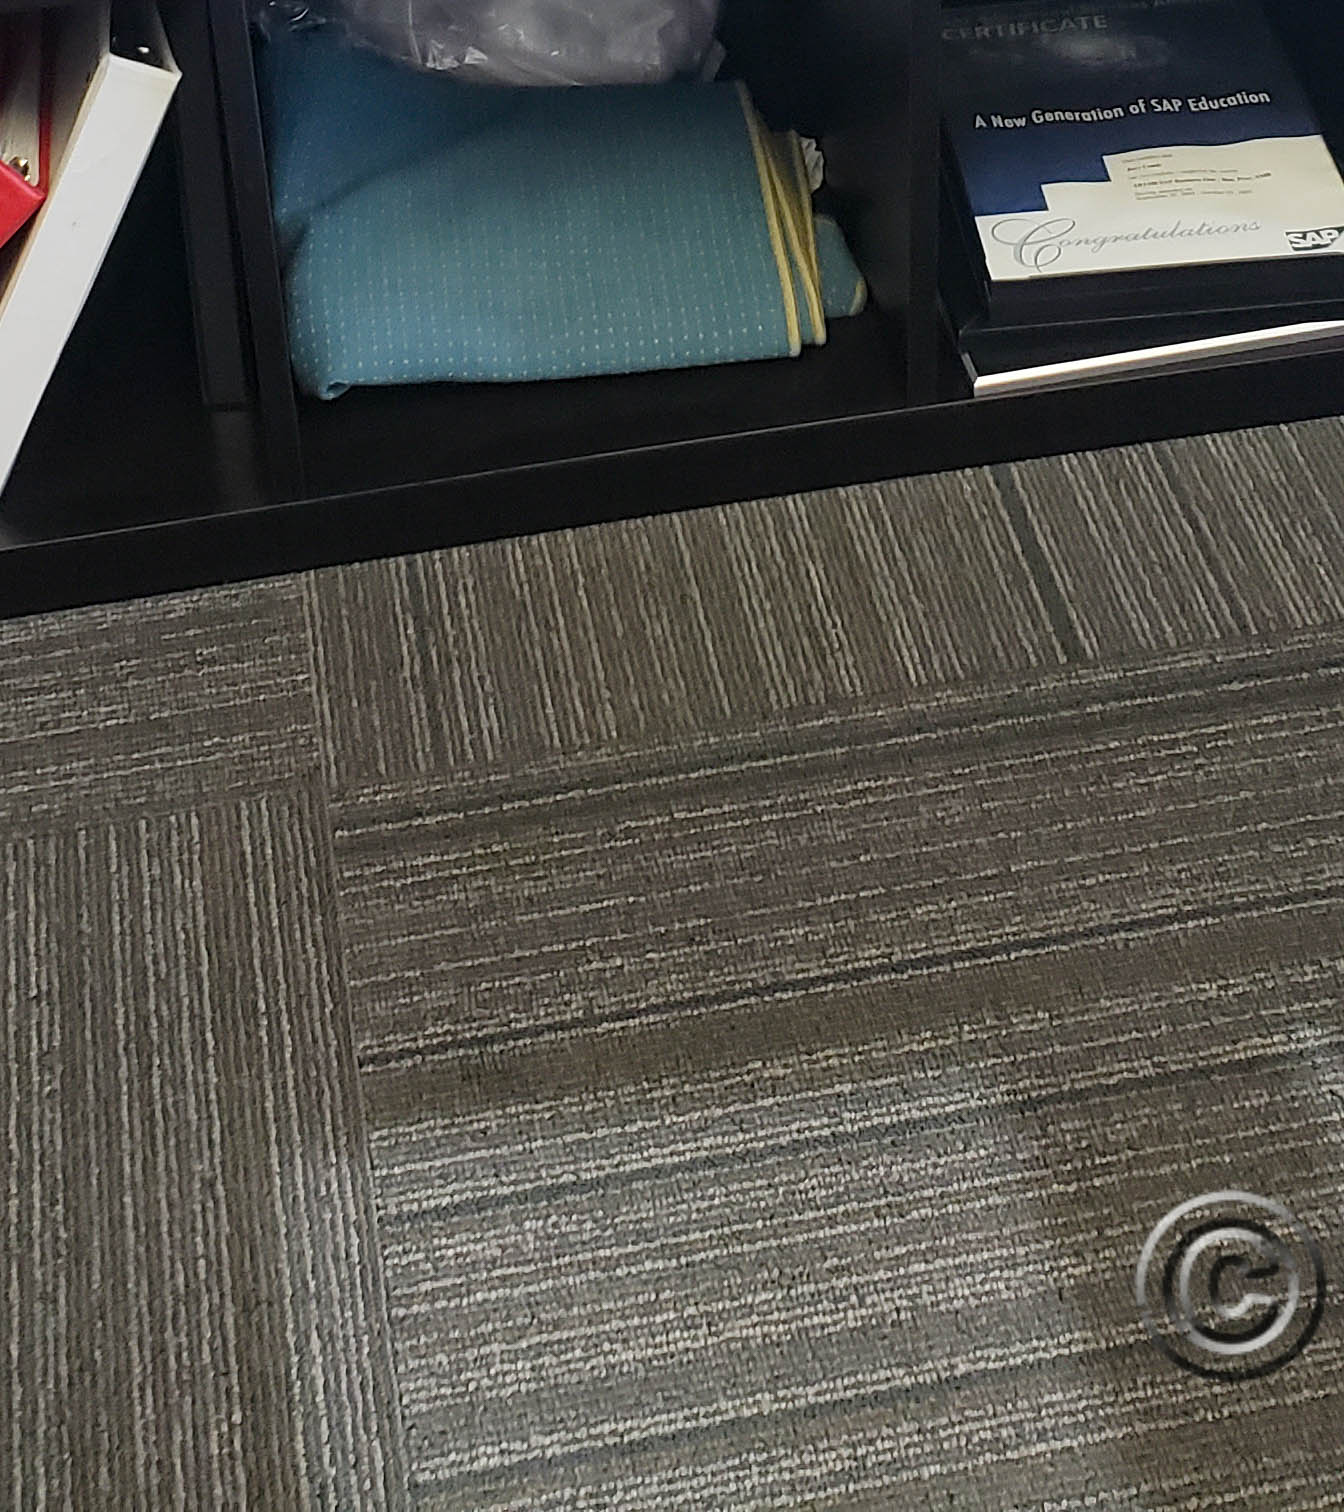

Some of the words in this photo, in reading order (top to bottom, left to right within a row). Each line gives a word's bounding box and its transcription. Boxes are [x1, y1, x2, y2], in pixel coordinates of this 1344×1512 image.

[974, 114, 987, 129] A
[992, 114, 1027, 129] New
[1031, 106, 1124, 126] Generation
[1128, 99, 1148, 115] of
[1150, 98, 1184, 114] SAP
[1188, 90, 1271, 113] Education
[991, 218, 1261, 274] Congratulations
[1287, 229, 1344, 250] SAP
